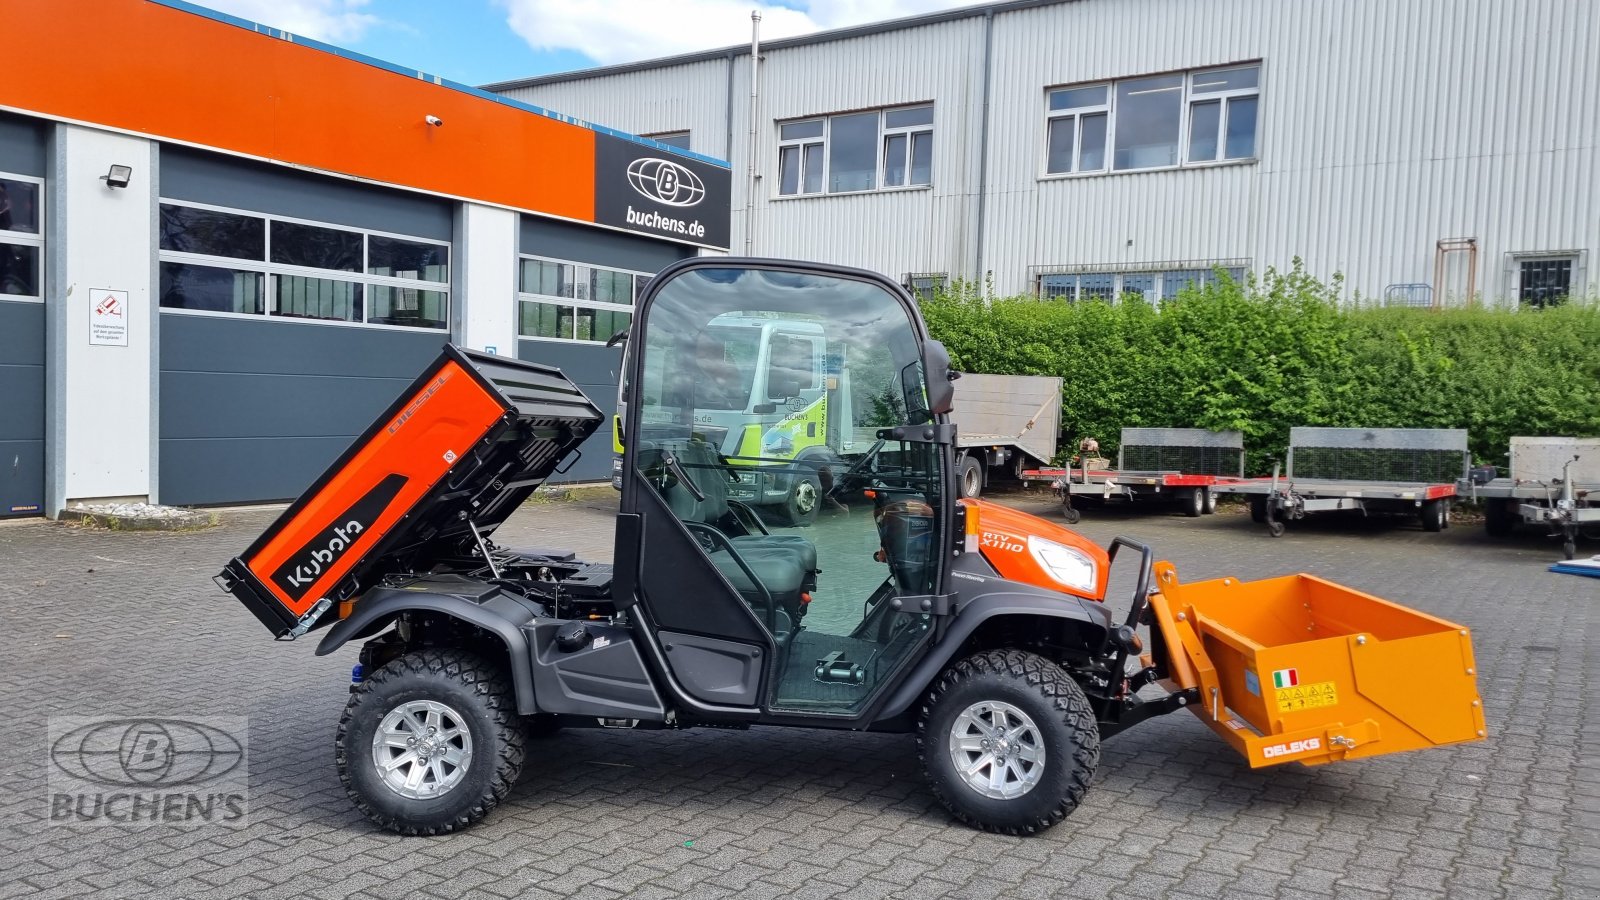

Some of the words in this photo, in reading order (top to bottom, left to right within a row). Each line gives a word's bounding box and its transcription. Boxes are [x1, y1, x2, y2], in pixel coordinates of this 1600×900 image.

[626, 205, 705, 238] buchens.de
[387, 371, 453, 435] DIESEL
[980, 538, 1024, 553] X1110
[982, 531, 1010, 541] RTV
[286, 520, 364, 588] Kubota
[1262, 737, 1320, 759] DELEKS
